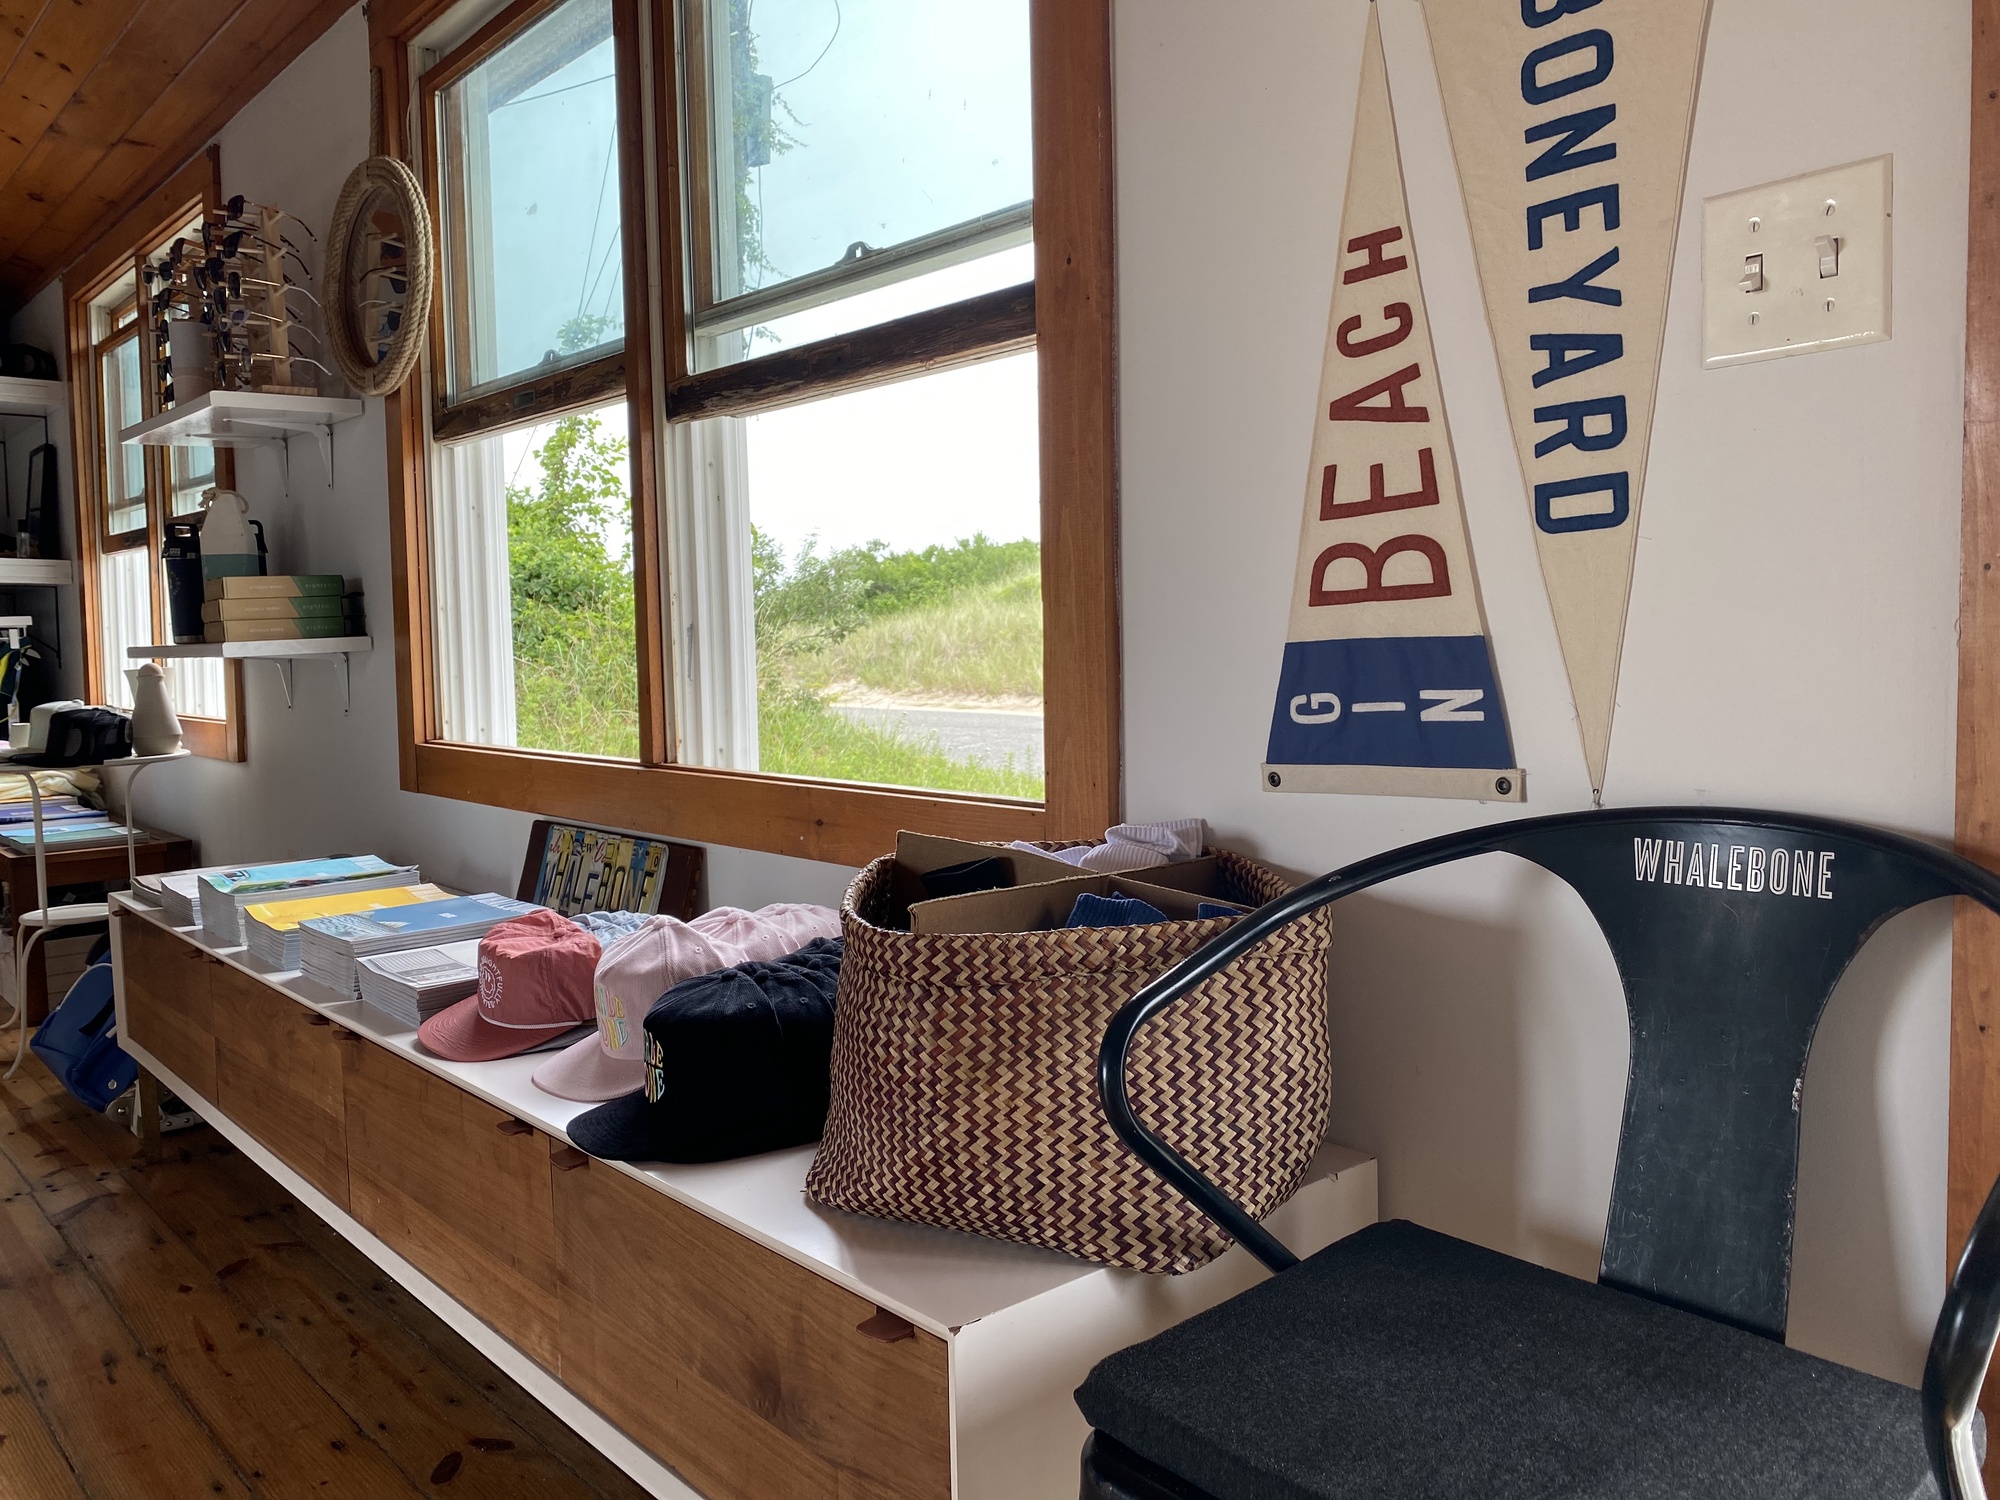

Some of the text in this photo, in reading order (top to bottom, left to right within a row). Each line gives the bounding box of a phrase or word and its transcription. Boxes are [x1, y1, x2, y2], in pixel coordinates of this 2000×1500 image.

[1308, 227, 1452, 608] BEACH
[1289, 689, 1485, 724] GIN
[1634, 837, 1835, 900] WHALEBONE
